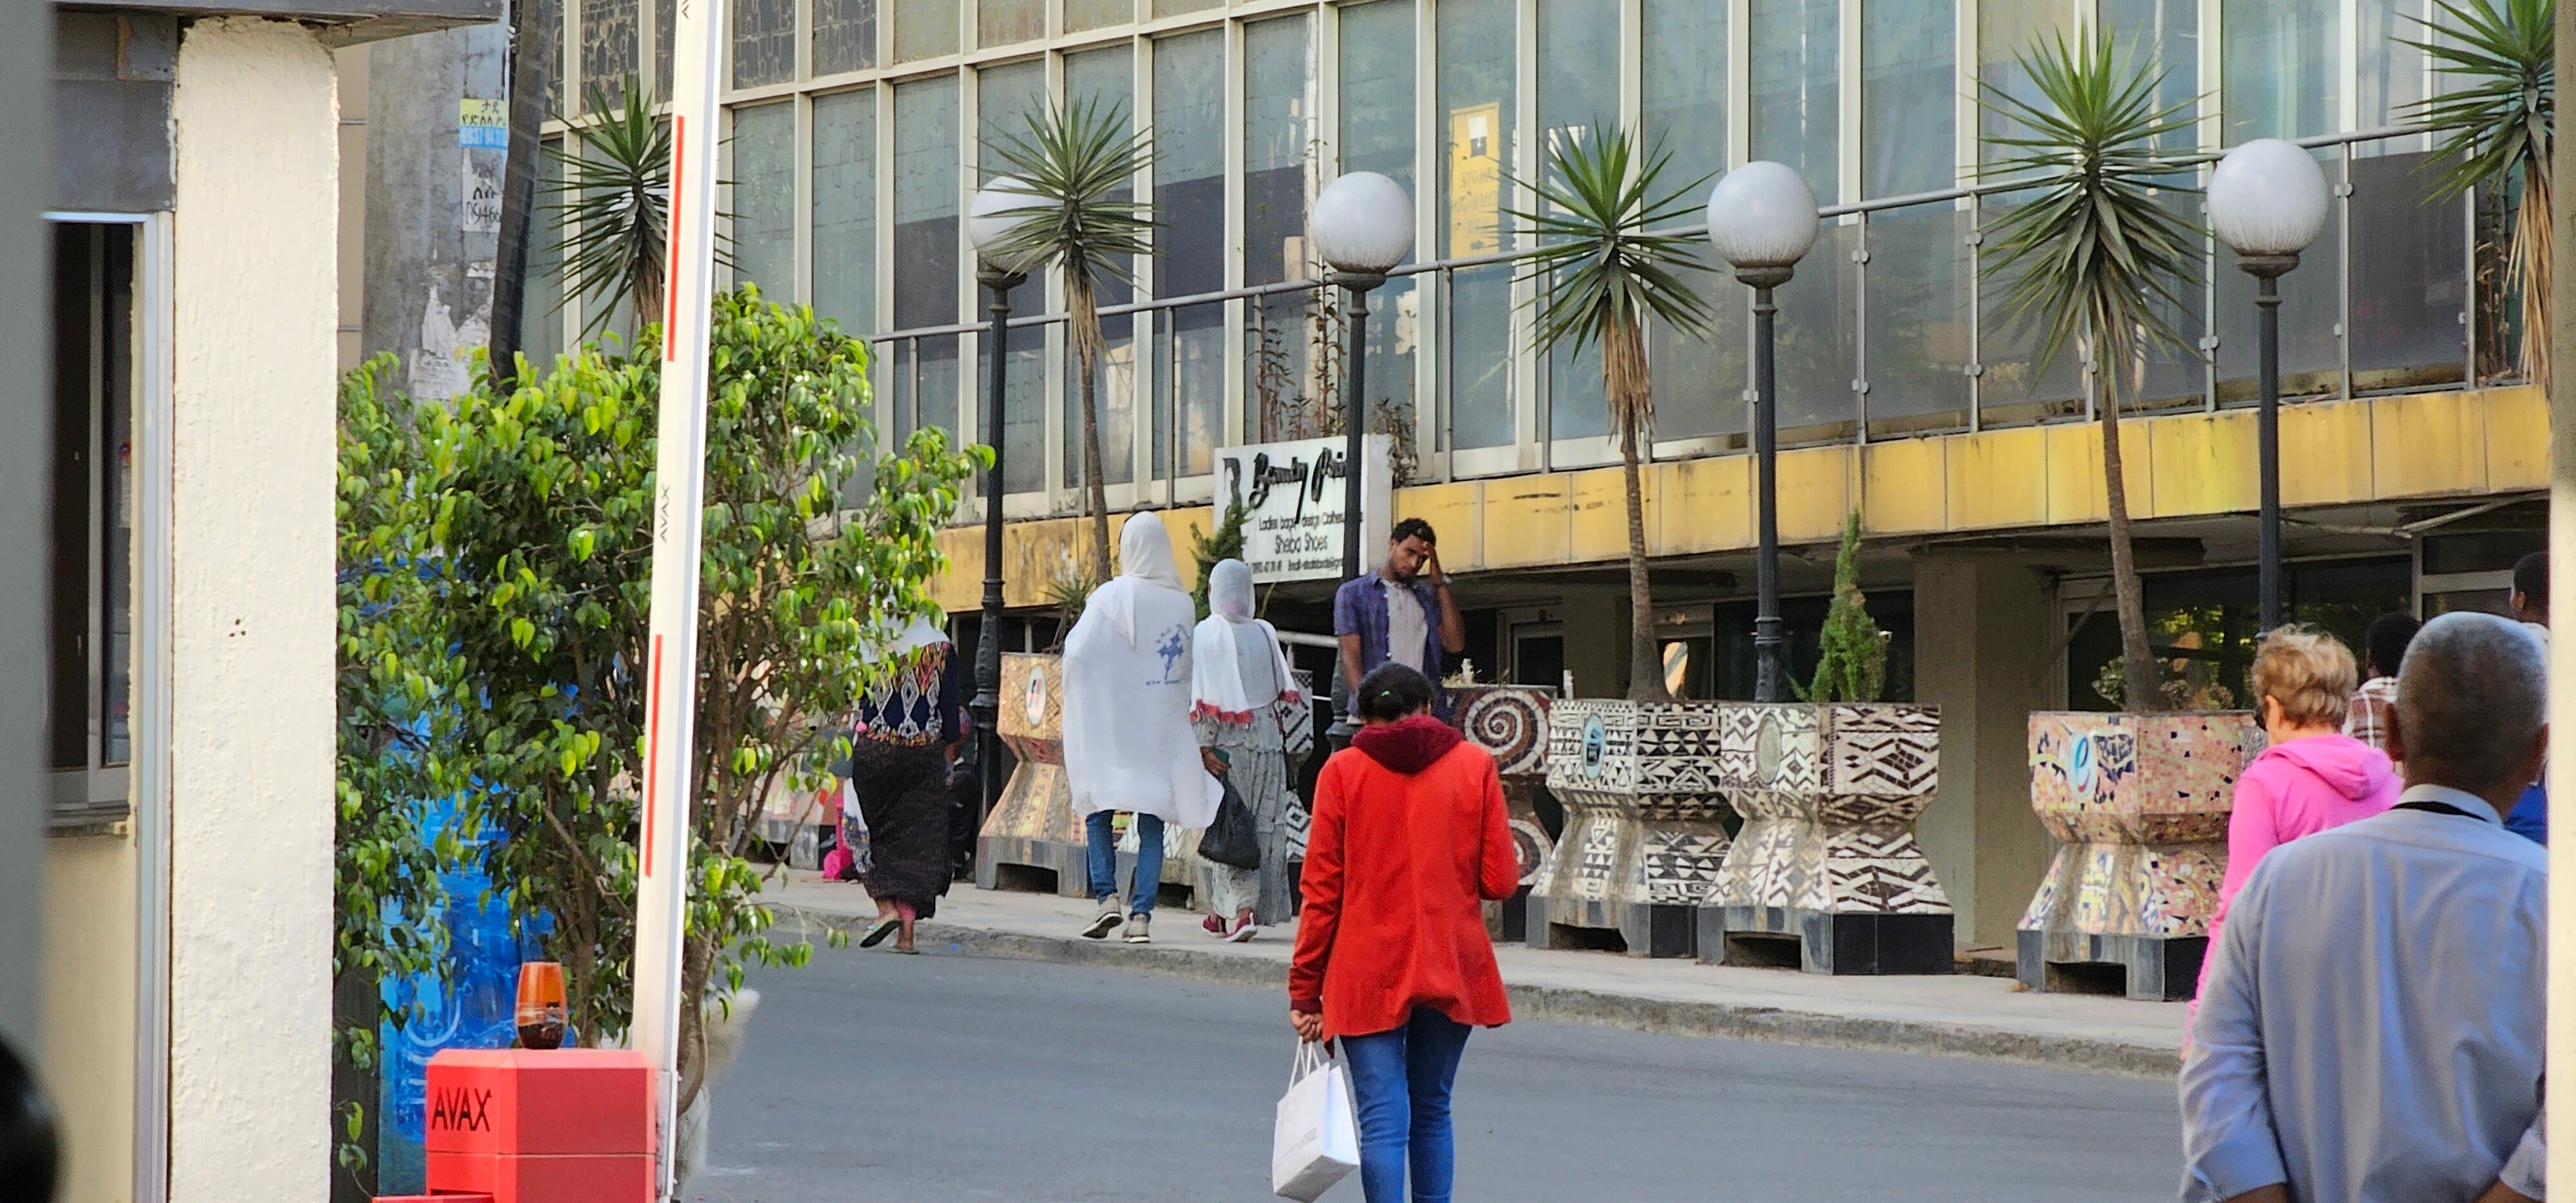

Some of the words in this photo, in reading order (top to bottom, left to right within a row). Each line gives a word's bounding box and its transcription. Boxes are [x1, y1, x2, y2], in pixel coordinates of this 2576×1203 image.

[660, 483, 670, 544] AVAX
[1305, 531, 1328, 552] Shoes
[431, 1086, 491, 1132] AVAX
